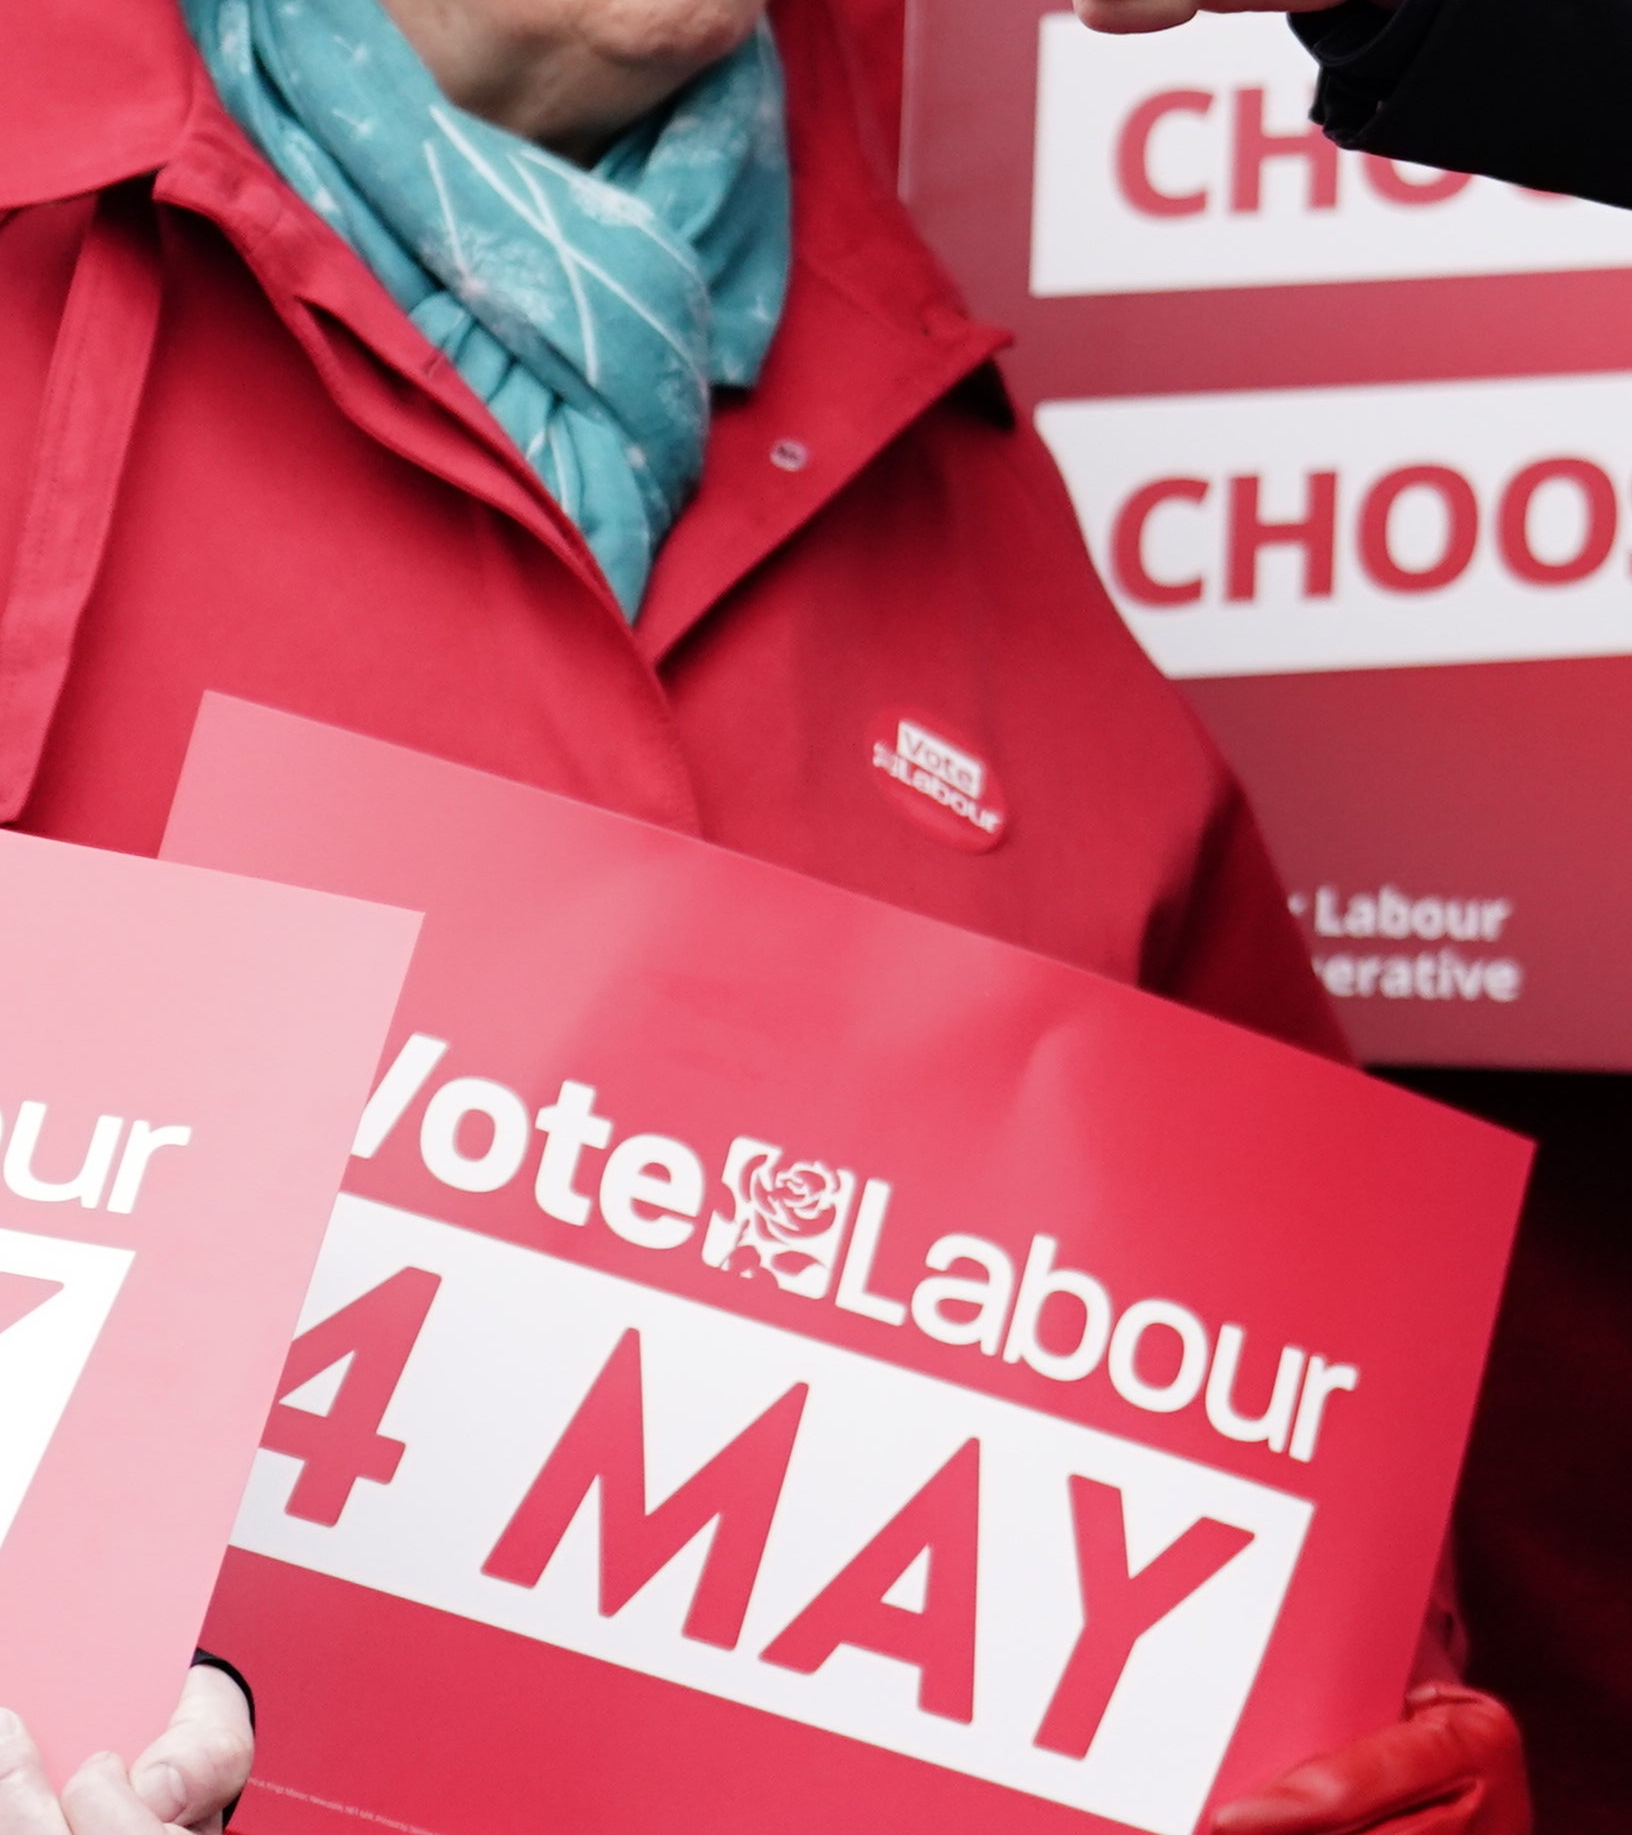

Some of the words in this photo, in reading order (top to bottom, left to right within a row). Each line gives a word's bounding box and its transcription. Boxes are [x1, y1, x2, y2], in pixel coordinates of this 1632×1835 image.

[892, 754, 1002, 834] Labour
[904, 730, 976, 790] Vote
[1313, 883, 1512, 941] Labour
[835, 1178, 1358, 1463] Labour
[258, 1266, 442, 1527] 4
[480, 1326, 1256, 1762] MAY
